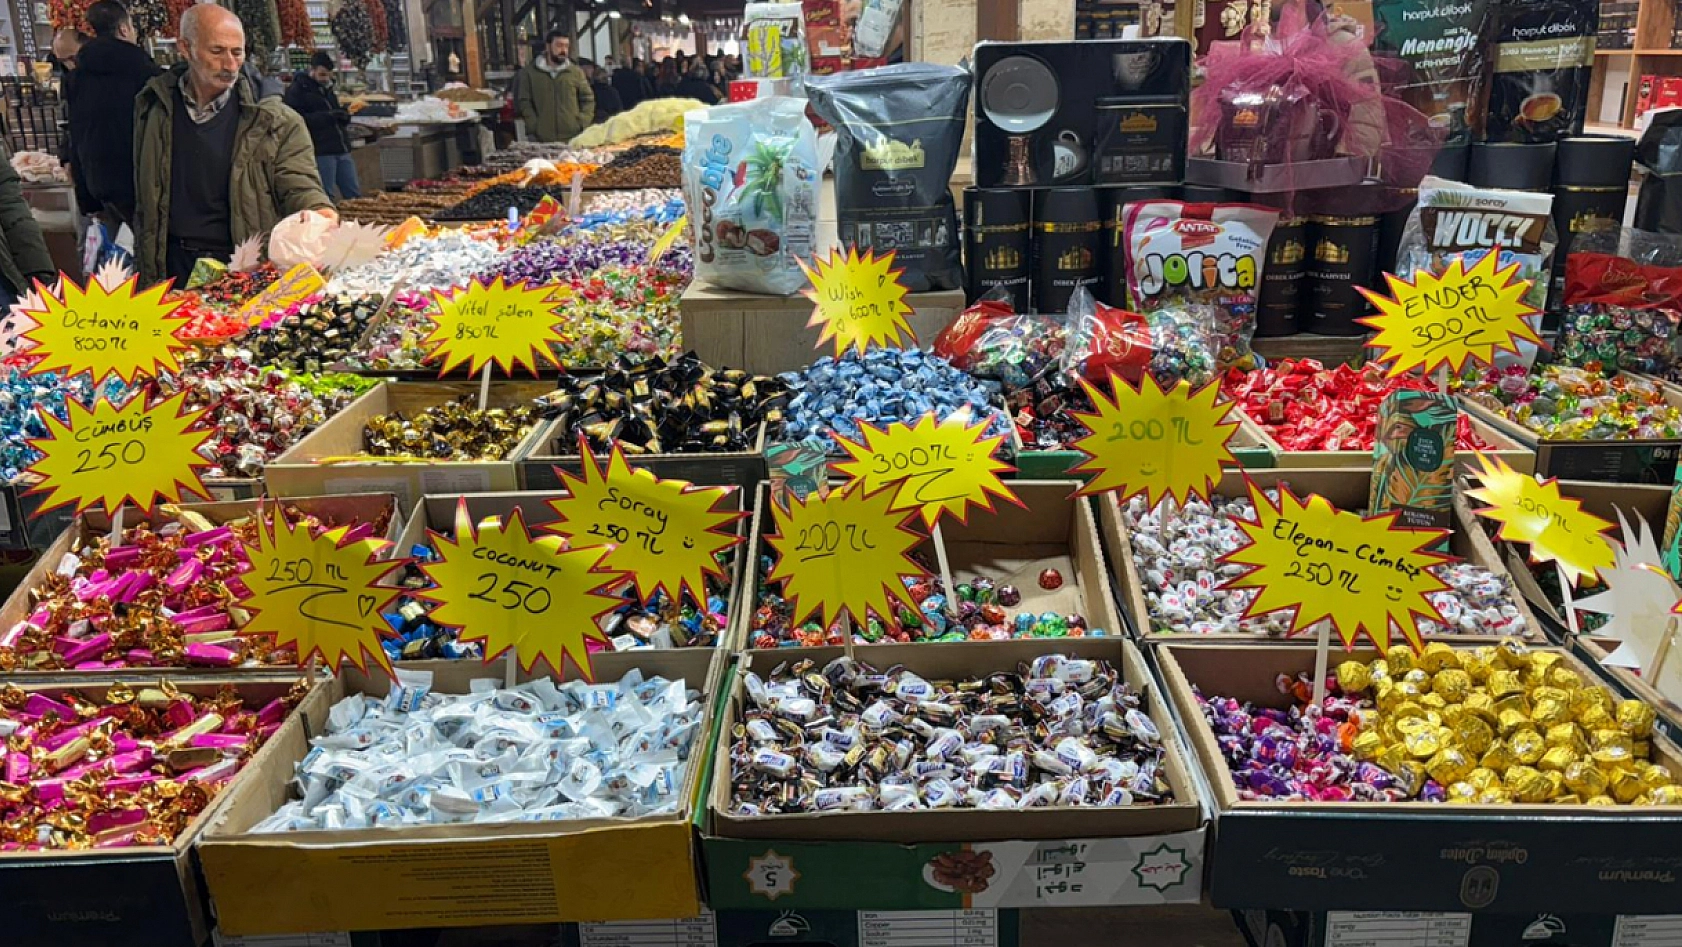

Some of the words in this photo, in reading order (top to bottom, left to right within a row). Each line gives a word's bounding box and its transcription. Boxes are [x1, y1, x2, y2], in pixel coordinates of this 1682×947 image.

[1402, 9, 1440, 21] harput
[1512, 25, 1547, 40] harput
[1141, 250, 1256, 297] Jolita
[828, 282, 864, 302] Wish
[1403, 276, 1498, 319] ENDER
[62, 310, 139, 331] Octavia
[457, 300, 489, 316] Vital
[73, 336, 107, 351] 800
[1106, 418, 1164, 442] 200
[1171, 416, 1204, 445] TL
[71, 439, 146, 475] 250
[597, 488, 668, 535] Soray
[1513, 494, 1549, 520] 200
[586, 523, 629, 544] 250
[636, 532, 664, 555] TL
[795, 521, 841, 551] 200
[265, 558, 314, 583] 250
[325, 564, 349, 581] TL
[471, 546, 562, 579] COCONUT
[1283, 561, 1334, 586] 250
[1338, 569, 1361, 594] TL
[467, 572, 552, 614] 250
[765, 871, 777, 887] 5
